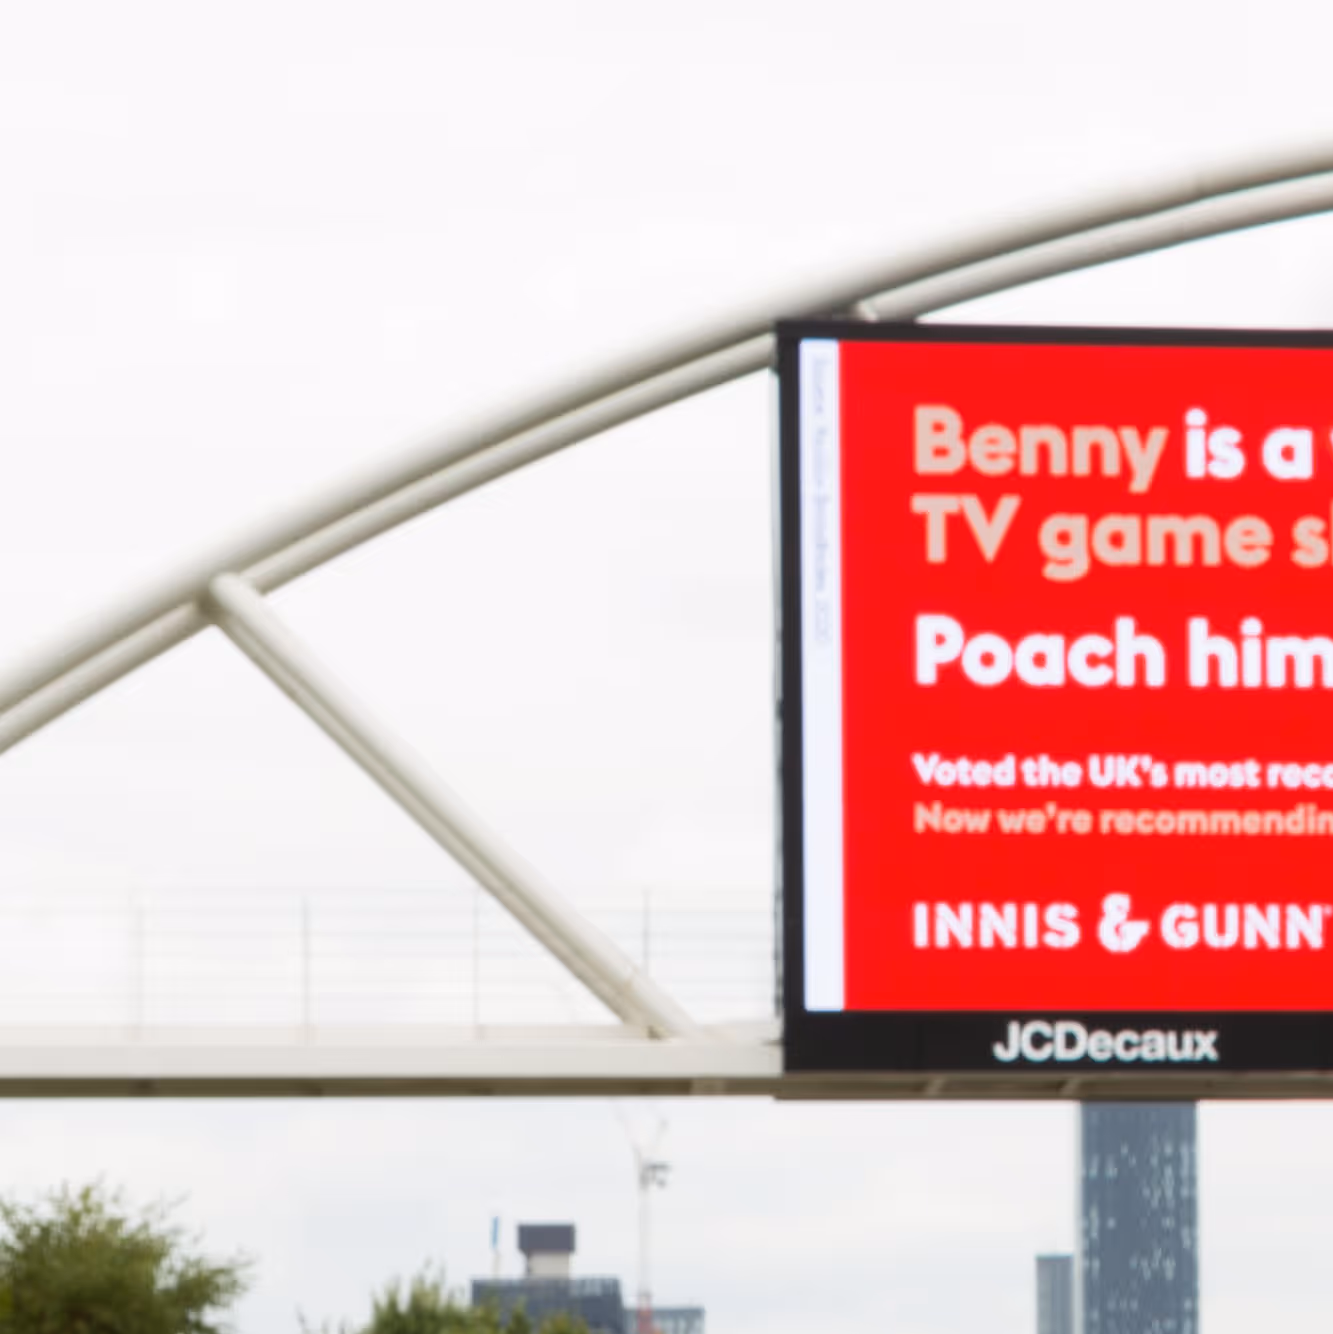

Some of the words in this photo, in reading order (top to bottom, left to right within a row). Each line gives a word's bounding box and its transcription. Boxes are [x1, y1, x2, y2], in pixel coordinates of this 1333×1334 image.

[915, 406, 1168, 492] Benny
[1185, 408, 1245, 479] is
[1262, 427, 1313, 480] a
[912, 494, 1019, 562] TV
[1039, 514, 1272, 581] game
[915, 614, 1165, 687] Poach
[912, 753, 1015, 786] Voted
[1021, 754, 1083, 787] the
[1088, 754, 1168, 788] UK's
[1174, 759, 1261, 788] most
[914, 802, 991, 833] Now
[998, 803, 1092, 833] we're
[914, 902, 1080, 948] INNIS
[1098, 893, 1150, 952] &
[1160, 903, 1326, 949] GUNN
[993, 1021, 1218, 1061] JCDecaux
